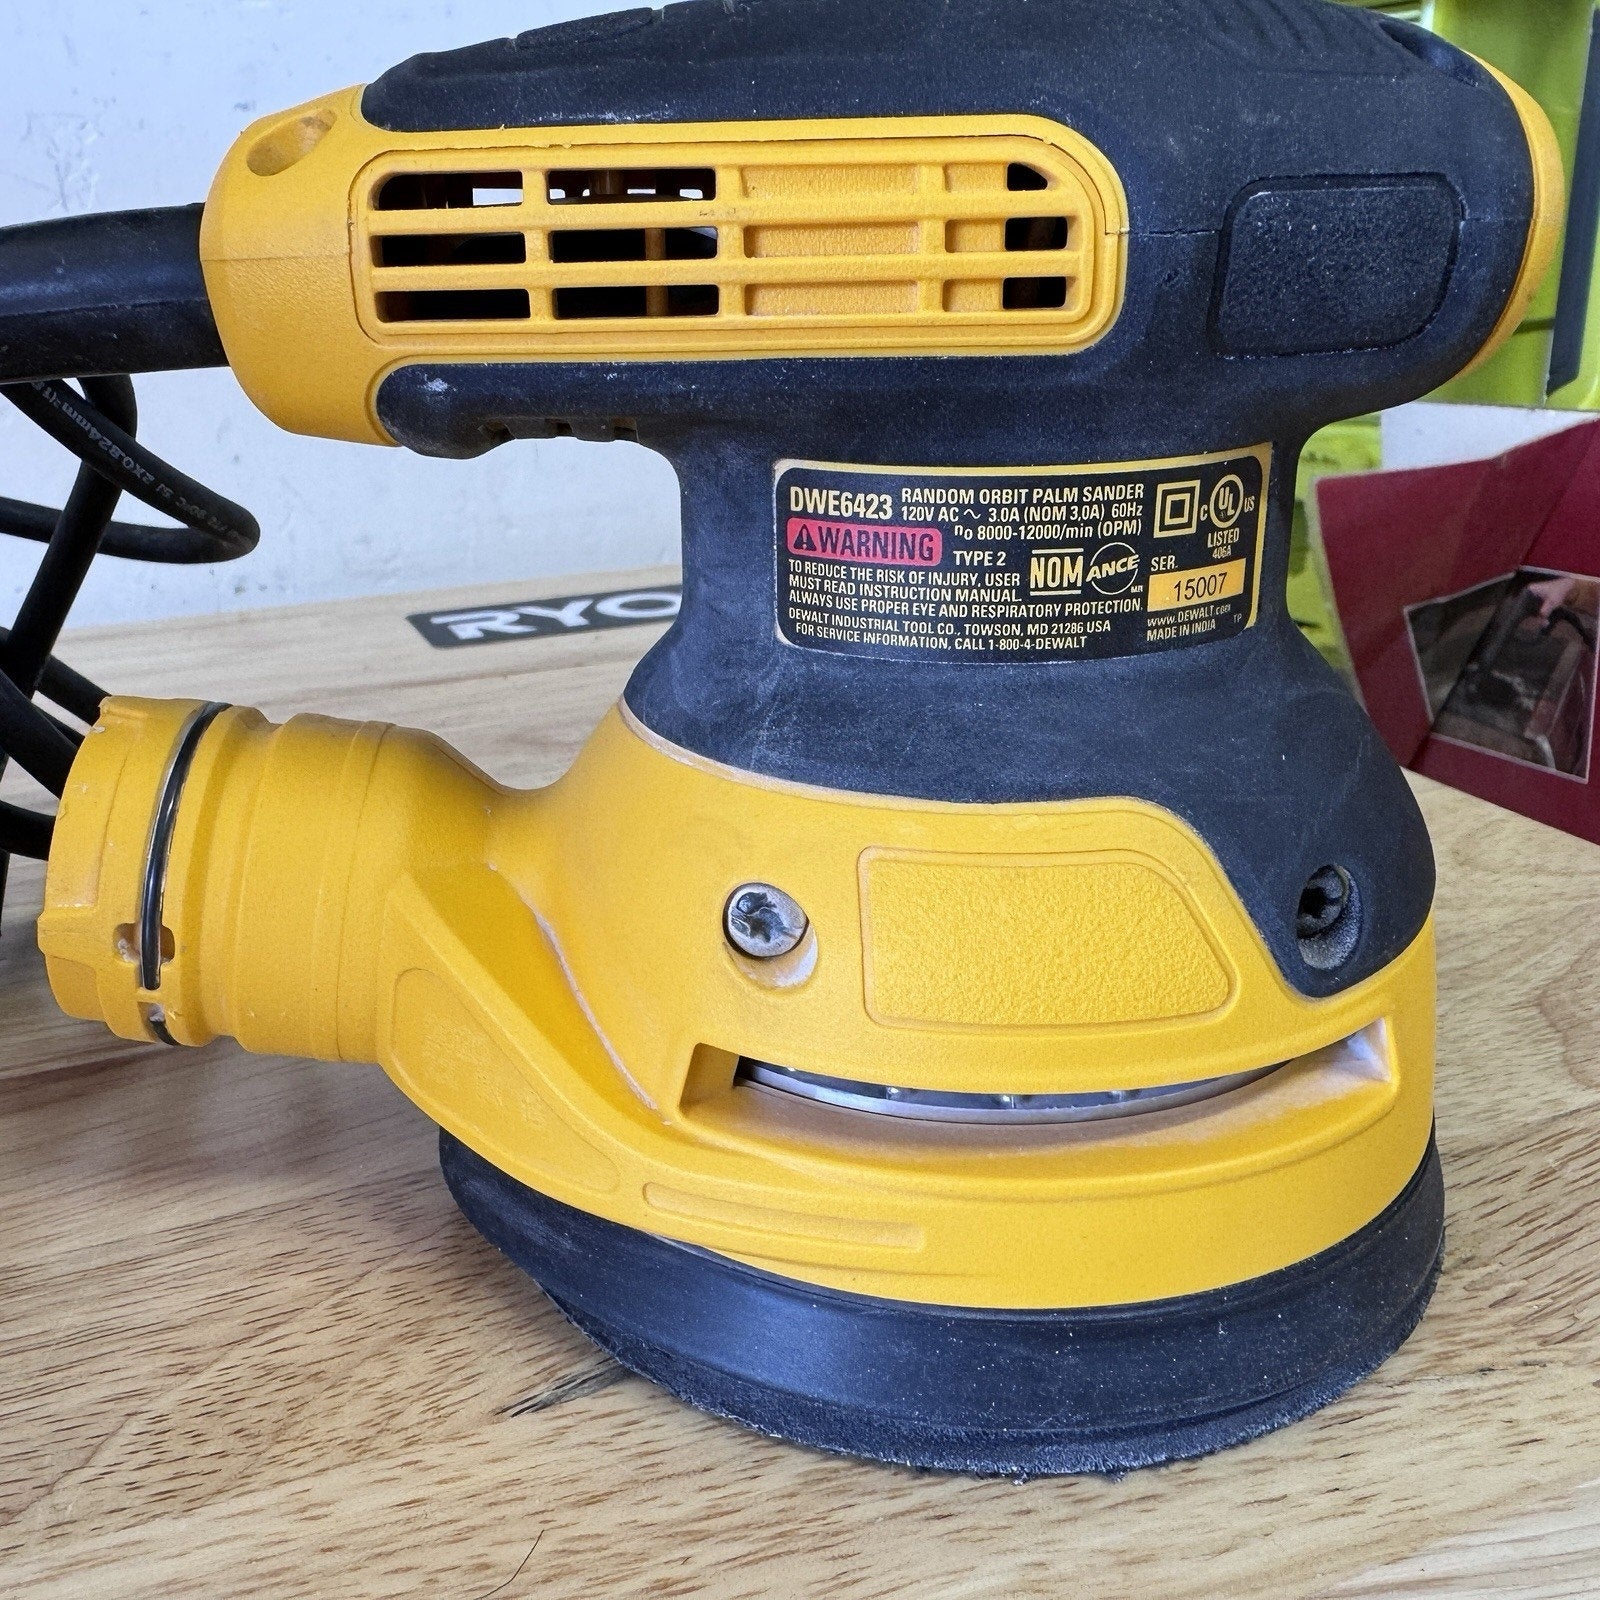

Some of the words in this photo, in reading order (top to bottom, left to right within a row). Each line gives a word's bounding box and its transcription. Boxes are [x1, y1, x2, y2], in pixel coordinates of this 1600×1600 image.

[790, 486, 893, 520] DWE6423
[901, 488, 974, 504] RANDOM
[979, 488, 1029, 504] ORBIT
[1032, 487, 1078, 503] PALM
[1083, 483, 1144, 502] SANDER
[1218, 486, 1235, 516] UL
[901, 506, 933, 522] 120V
[938, 507, 959, 522] AC
[988, 507, 1020, 522] 3.0A
[1024, 505, 1066, 523] (NOM
[1111, 501, 1142, 519] 60Hz
[818, 526, 934, 561] WARNING
[977, 523, 1093, 540] 8000-12000/min
[1097, 519, 1142, 538] (OPM)
[1207, 528, 1240, 548] LISTED
[953, 550, 993, 567] TYPE
[997, 550, 1006, 567] 2
[1030, 556, 1084, 588] NOM
[1085, 554, 1140, 582] ANCE
[1151, 555, 1178, 572] SER.
[789, 559, 801, 573] TO
[804, 561, 847, 579] REDUCE
[850, 566, 873, 582] THE
[876, 568, 905, 583] RISK
[909, 571, 926, 585] OF
[929, 572, 981, 587] INJURY,
[985, 573, 1020, 587] USER
[1174, 572, 1228, 601] 15007
[789, 574, 821, 591] MUST
[824, 579, 856, 596] READ
[860, 583, 951, 602] INSTRUCTION
[956, 588, 1022, 602] MANUAL.
[789, 589, 833, 608] ALWAYS
[836, 596, 858, 612] USE
[861, 599, 909, 616] PROPER
[913, 603, 936, 617] EYE
[939, 604, 968, 618] AND
[971, 603, 1062, 618] RESPIRATORY
[1065, 598, 1143, 616] PROTECTION.
[789, 607, 829, 625] DEWALT
[832, 615, 899, 632] INDUSTRIAL
[903, 620, 934, 635] TOOL
[964, 623, 1024, 637] TOWSON,
[1027, 623, 1048, 636] MD
[1051, 621, 1083, 635] 21286
[1086, 620, 1111, 633] USA
[796, 622, 814, 636] FOR
[817, 626, 860, 643] SERVICE
[863, 633, 951, 650] INFORMATION,
[954, 638, 985, 650] CALL
[989, 636, 1087, 650] 1-800-4-DEWALT
[1146, 626, 1177, 641] MADE
[1180, 624, 1190, 637] IN
[1192, 619, 1216, 634] INDIA
